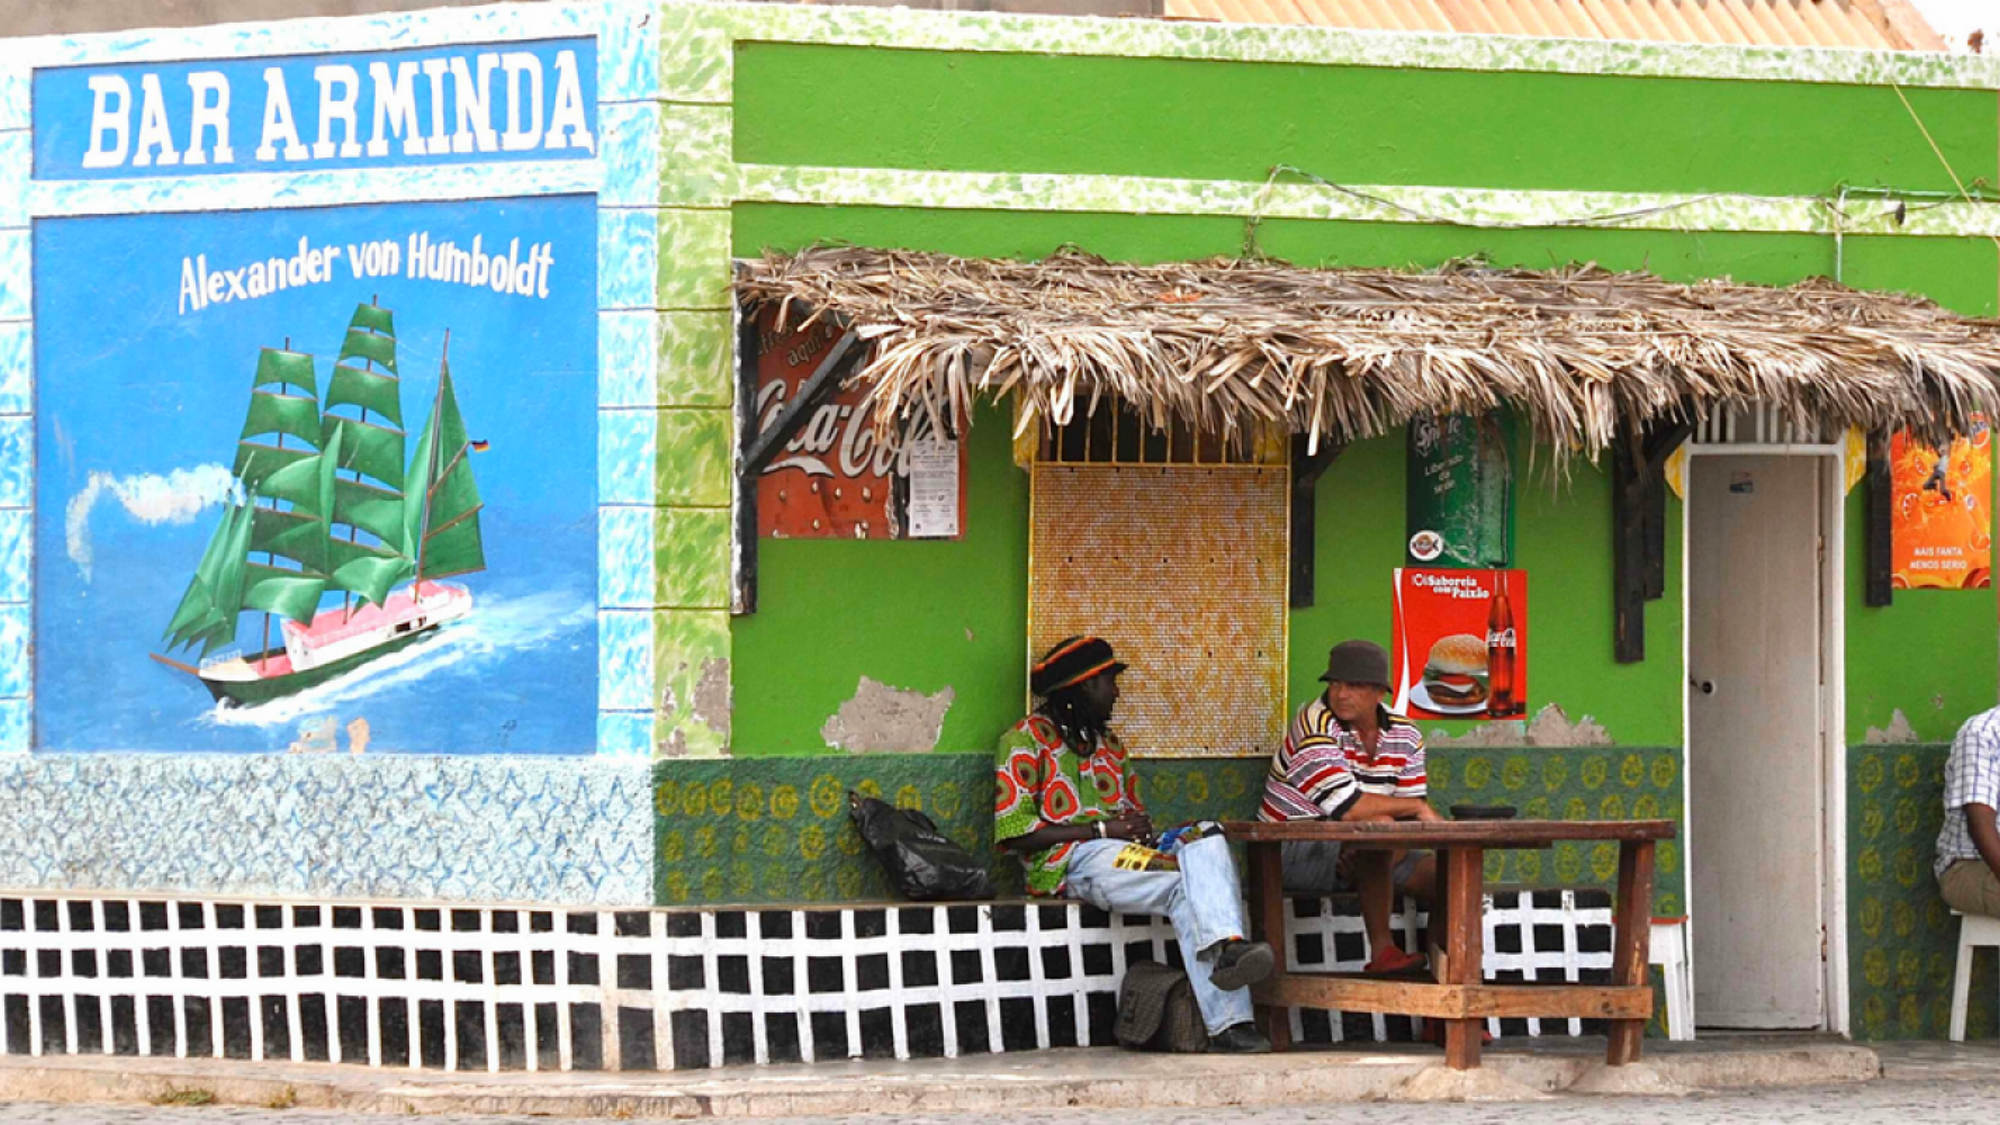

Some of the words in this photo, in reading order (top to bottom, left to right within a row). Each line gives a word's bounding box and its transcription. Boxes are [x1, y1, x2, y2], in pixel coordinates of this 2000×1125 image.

[82, 71, 234, 168] BAR
[256, 49, 595, 161] ARMINDA
[178, 235, 341, 315] Alexander
[346, 238, 399, 278] von
[407, 231, 554, 299] Humboldt
